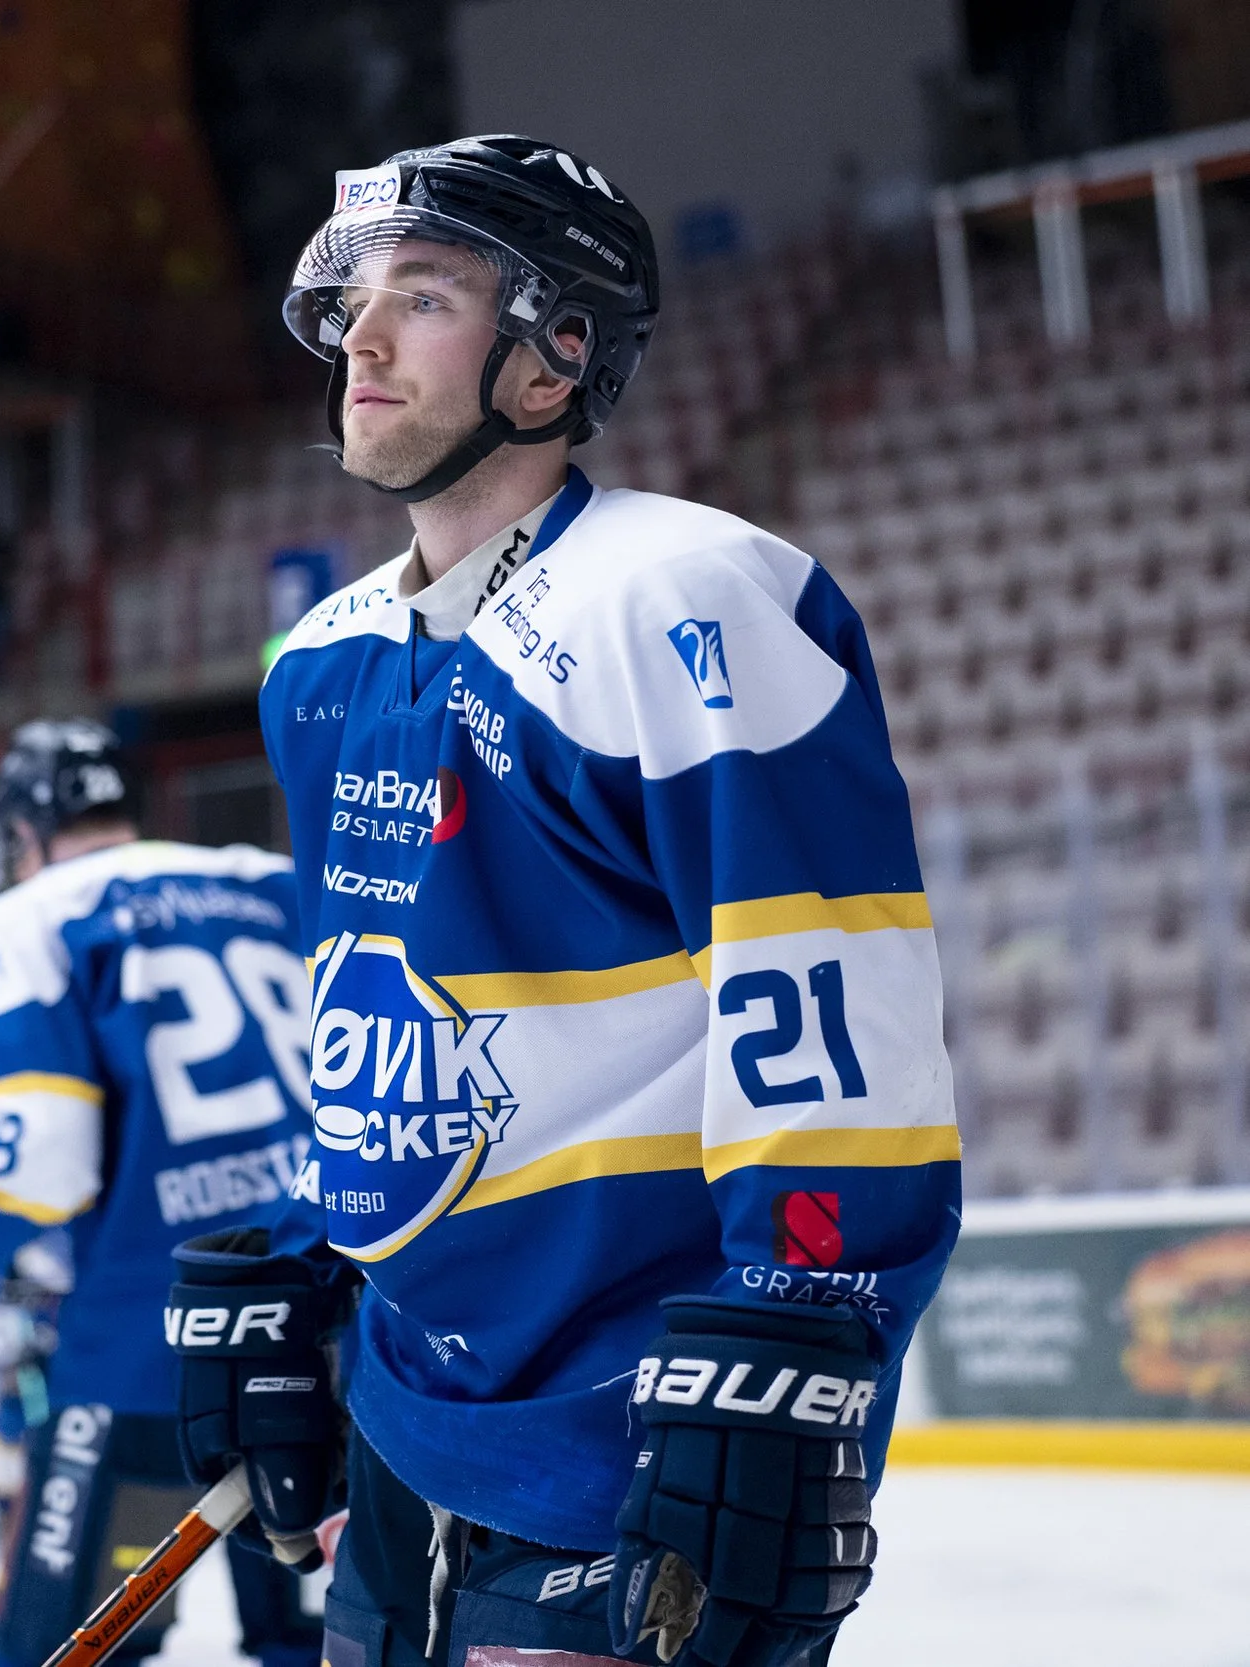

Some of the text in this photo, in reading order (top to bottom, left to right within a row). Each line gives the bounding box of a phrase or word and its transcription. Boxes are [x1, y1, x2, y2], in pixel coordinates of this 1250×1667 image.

[565, 226, 626, 272] BAUER
[474, 527, 531, 618] CM
[538, 640, 578, 685] AS
[296, 704, 346, 722] EAG
[717, 959, 868, 1109] 21
[341, 1189, 386, 1214] 1990
[633, 1357, 878, 1427] BAUER
[102, 1567, 168, 1639] BAUER
